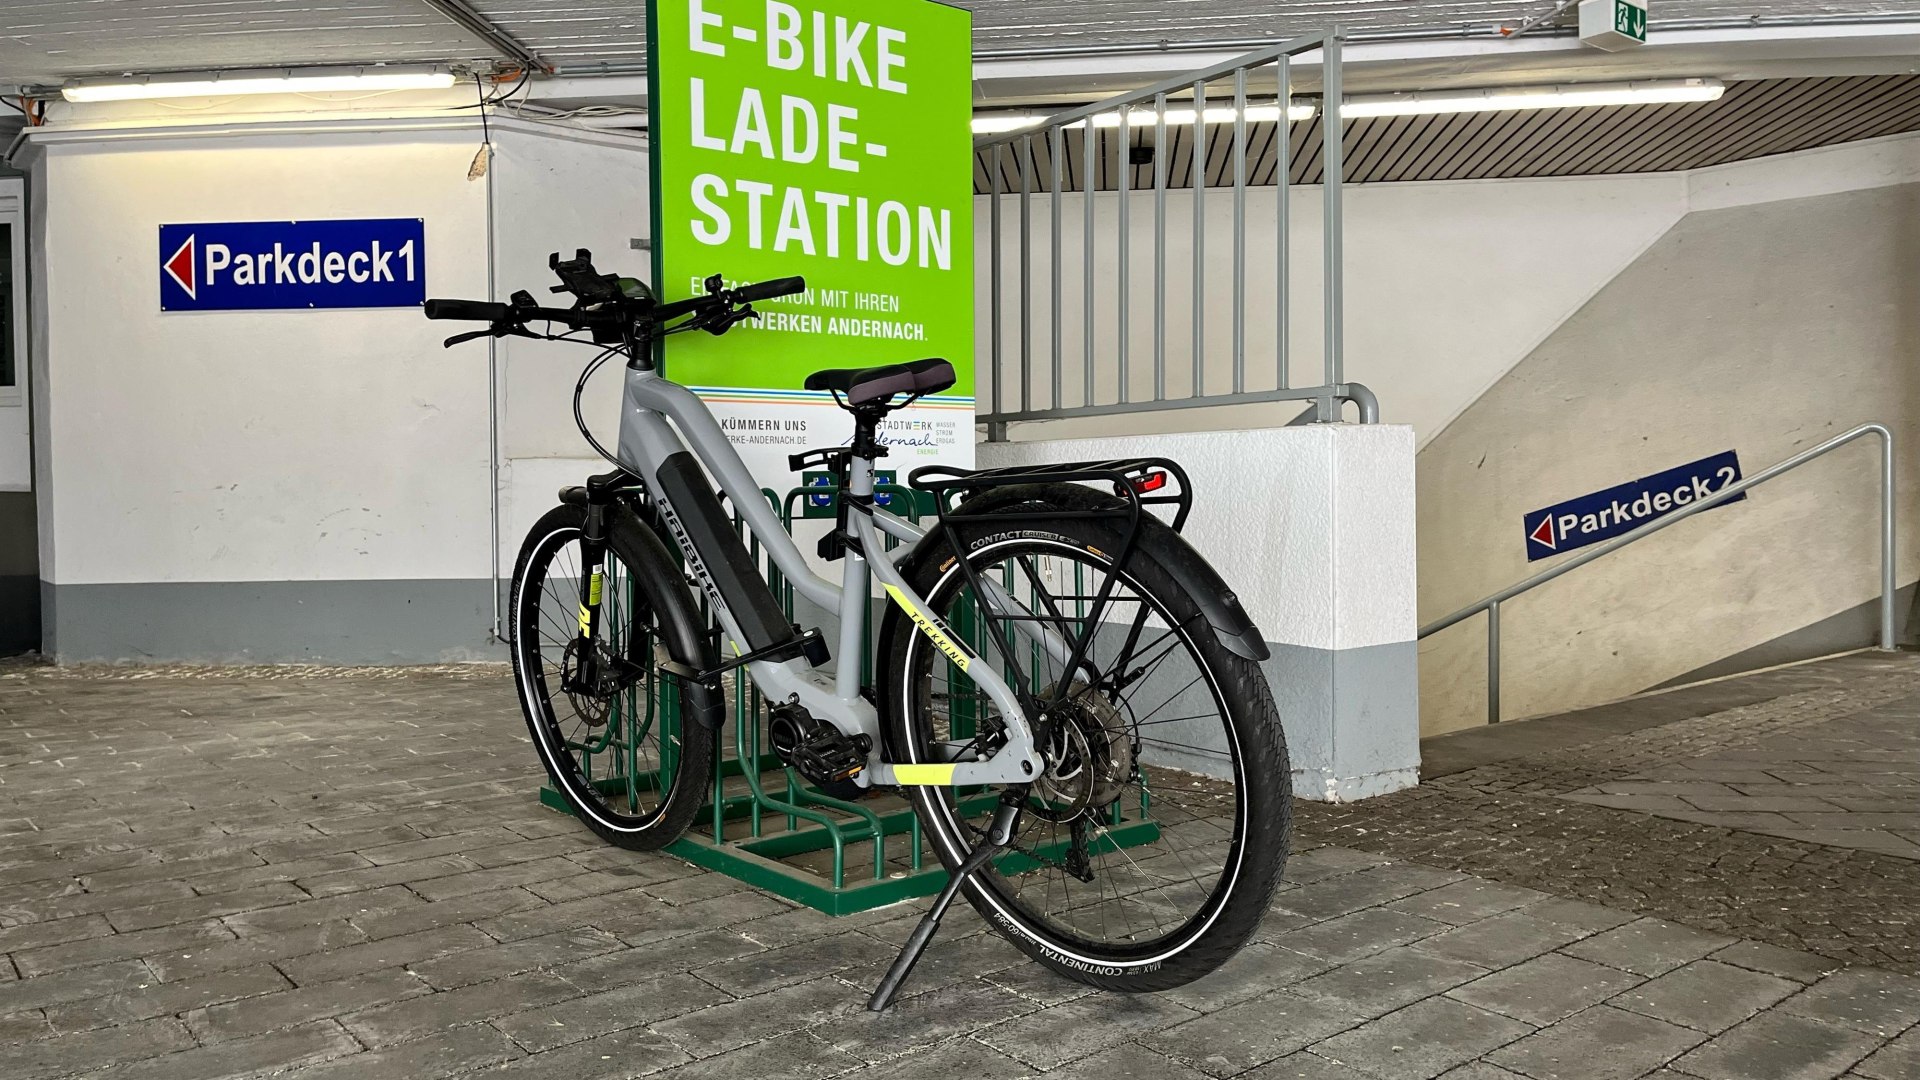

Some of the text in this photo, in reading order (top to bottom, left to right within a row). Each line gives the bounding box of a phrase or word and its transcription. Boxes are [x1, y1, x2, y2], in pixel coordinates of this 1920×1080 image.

[689, 0, 907, 94] E-BIKE
[690, 77, 887, 172] LADE-
[690, 173, 951, 271] STATION
[821, 288, 849, 308] MIT
[855, 292, 899, 313] IHREN
[732, 310, 929, 341] TWERKEN ANDERNACH.
[721, 417, 807, 431] KÜMMERN UNS
[1558, 466, 1736, 541] Parkdeck 2
[970, 530, 1022, 550] CONTACT
[911, 612, 966, 667] TREKKING
[1039, 944, 1123, 977] CONTINENTAL
